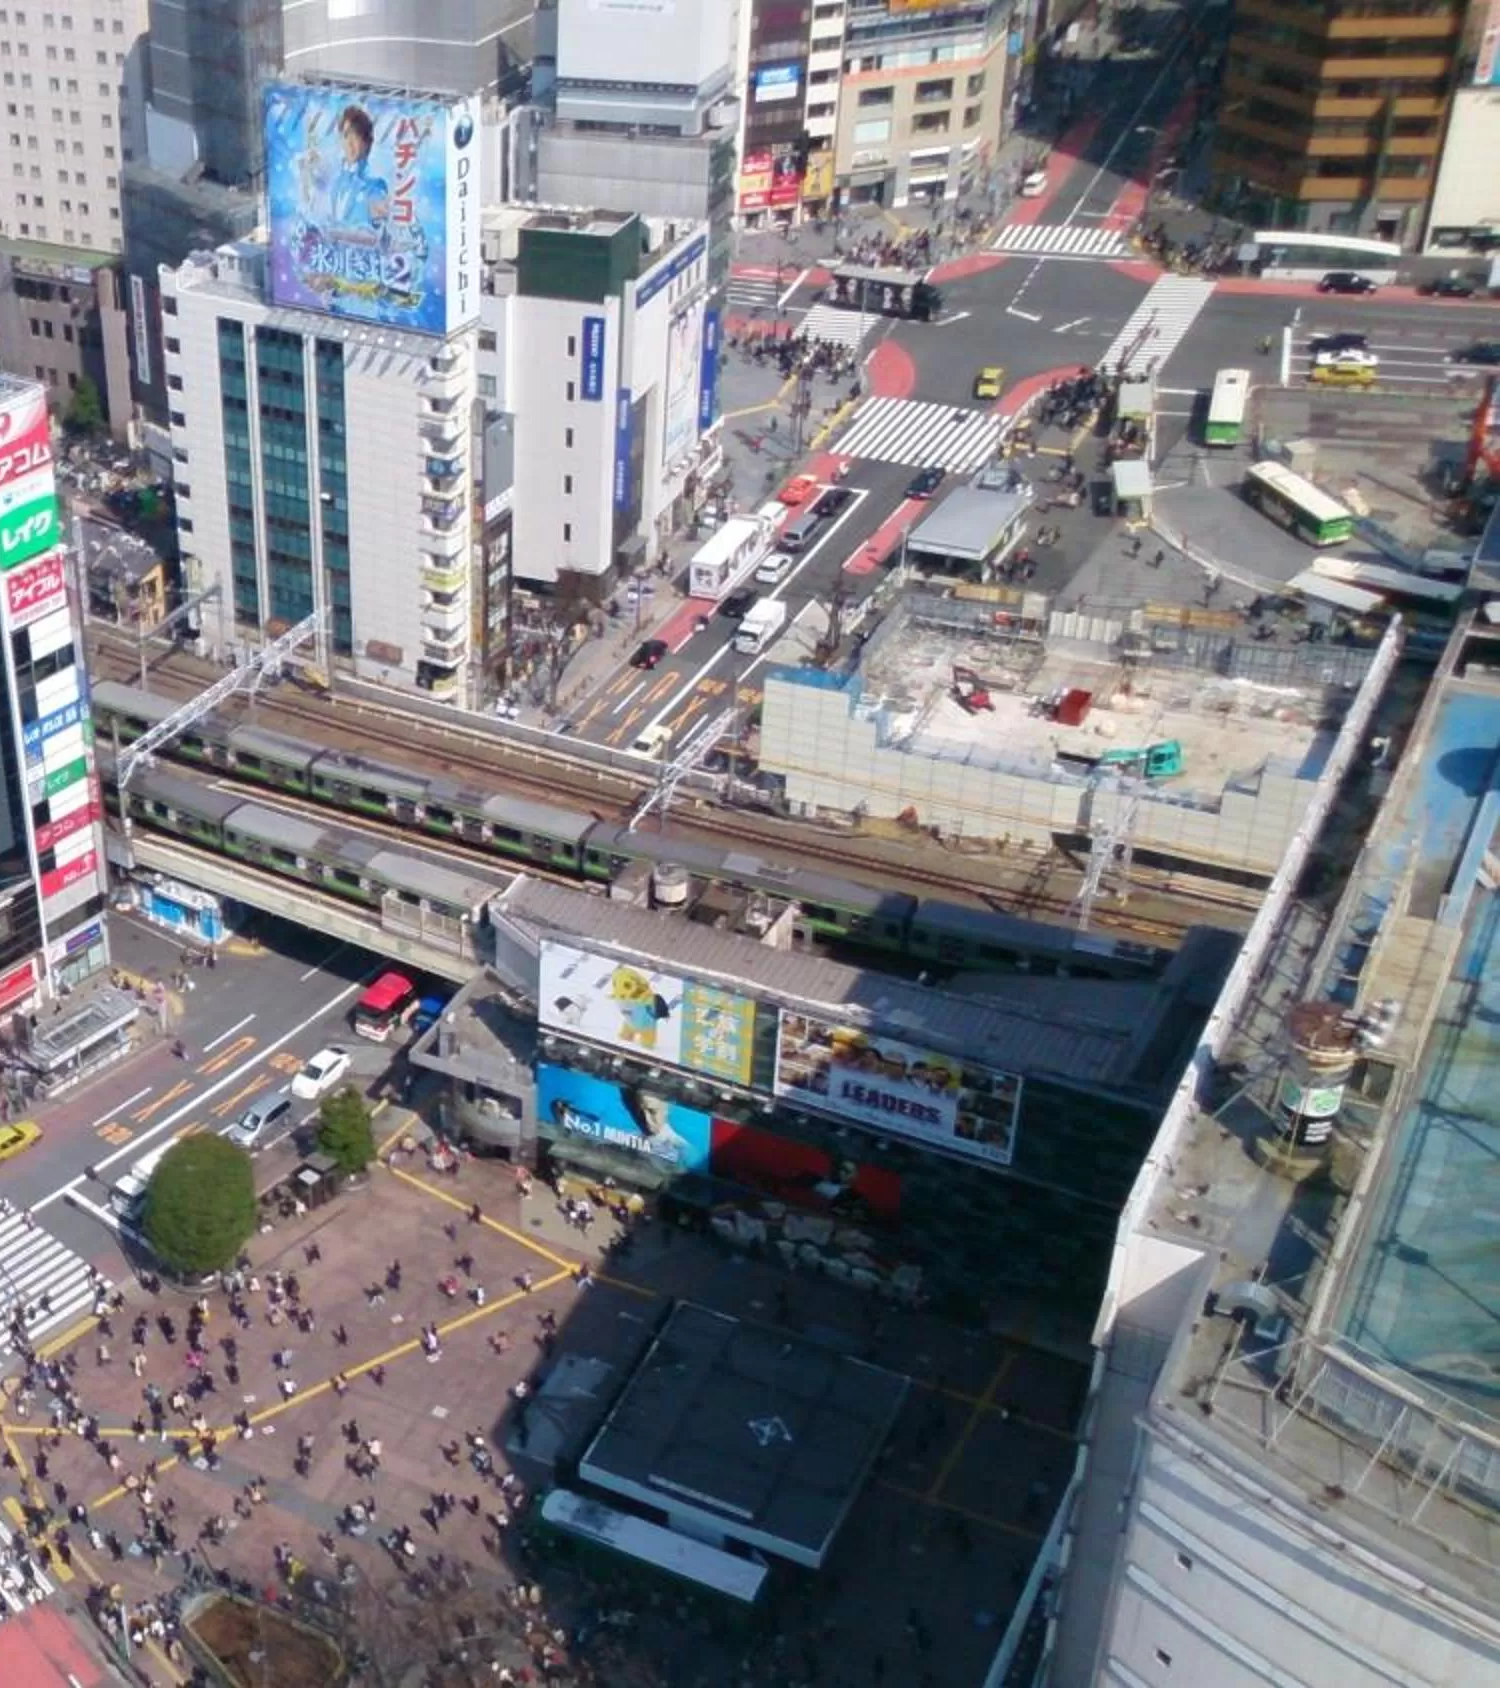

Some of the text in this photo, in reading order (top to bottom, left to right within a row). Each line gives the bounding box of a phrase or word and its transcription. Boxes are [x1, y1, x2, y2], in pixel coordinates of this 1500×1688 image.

[392, 118, 419, 223] パチンコ
[456, 157, 471, 314] Daiichi
[2, 510, 53, 552] レイク
[841, 1080, 942, 1125] LEADERS
